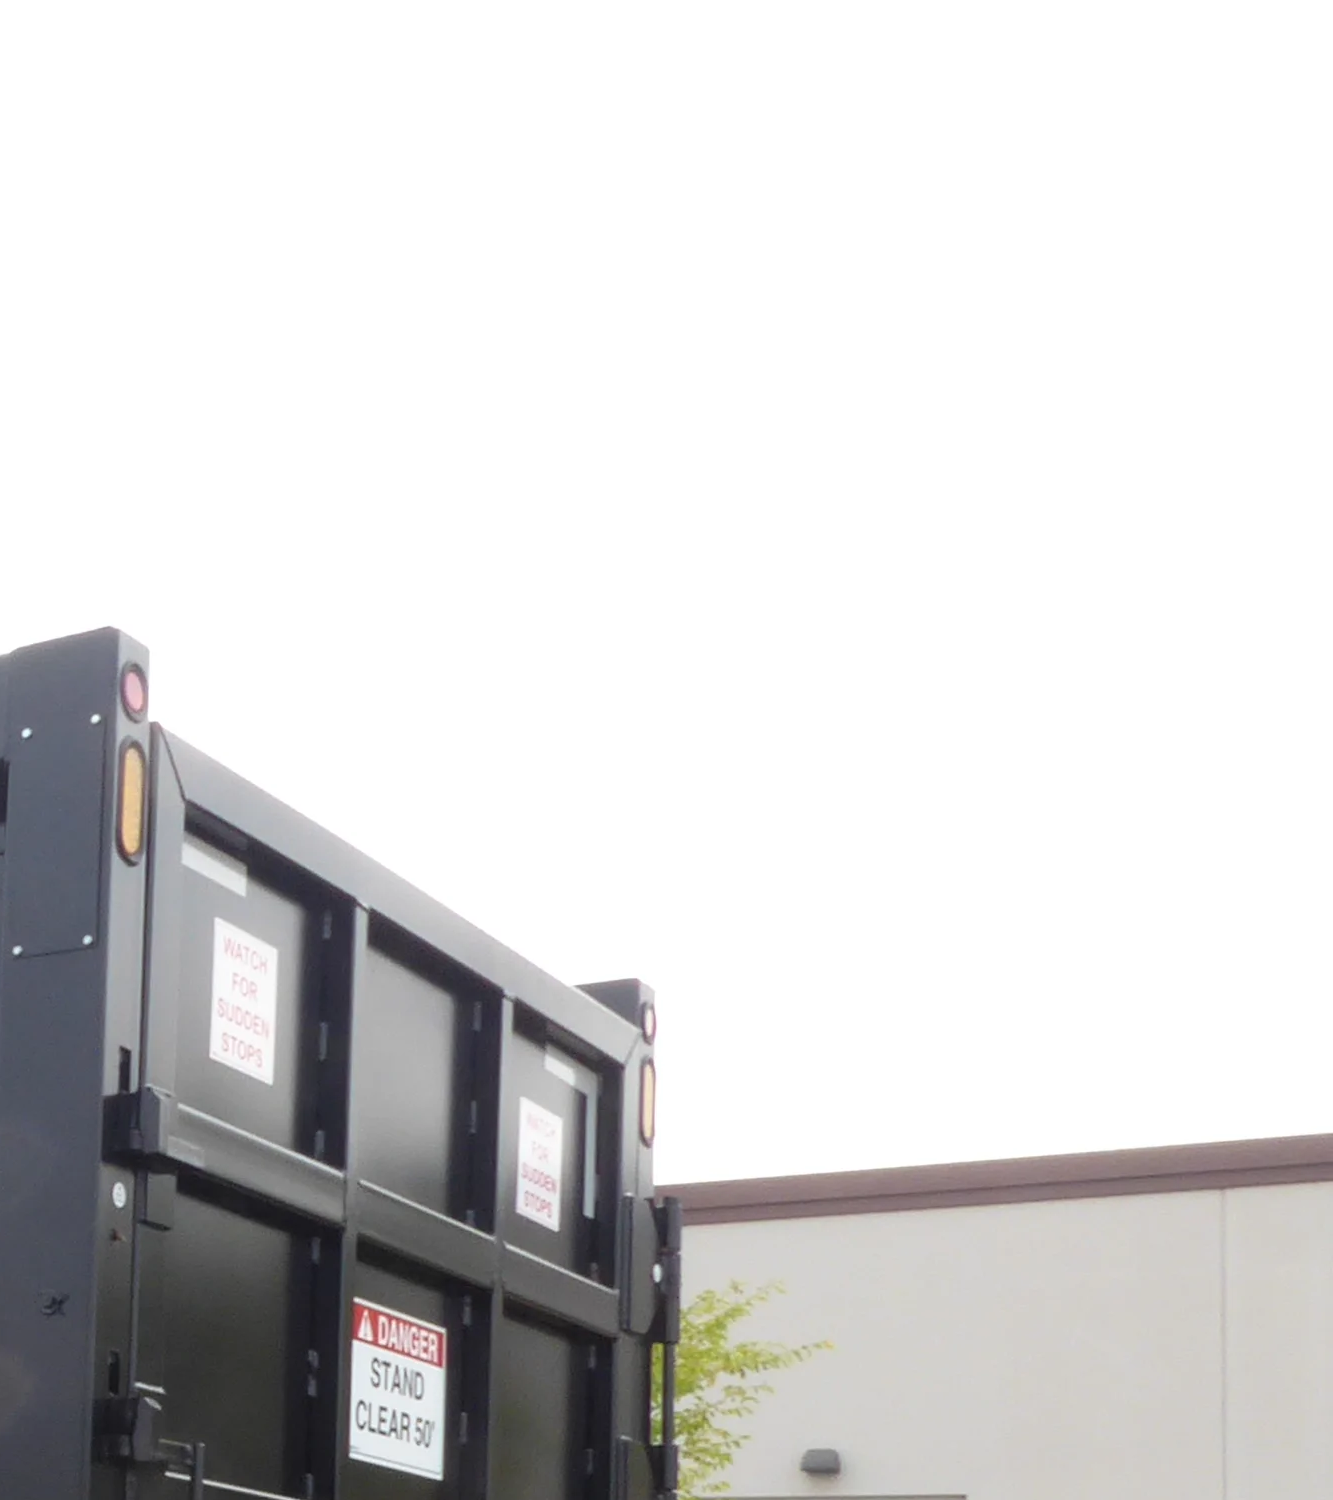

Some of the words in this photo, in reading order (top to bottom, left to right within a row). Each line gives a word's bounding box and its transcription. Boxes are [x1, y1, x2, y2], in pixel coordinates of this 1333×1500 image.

[223, 935, 268, 975] WATCH
[232, 972, 258, 999] FOR
[217, 998, 270, 1040] SUDDEN
[221, 1032, 263, 1069] STOPS
[521, 1162, 557, 1196] SUDDEN
[523, 1189, 552, 1219] STOPS
[378, 1315, 438, 1363] DANGER
[370, 1357, 425, 1401] STAND
[355, 1401, 411, 1443] CLEAR
[413, 1419, 436, 1448] 50'
